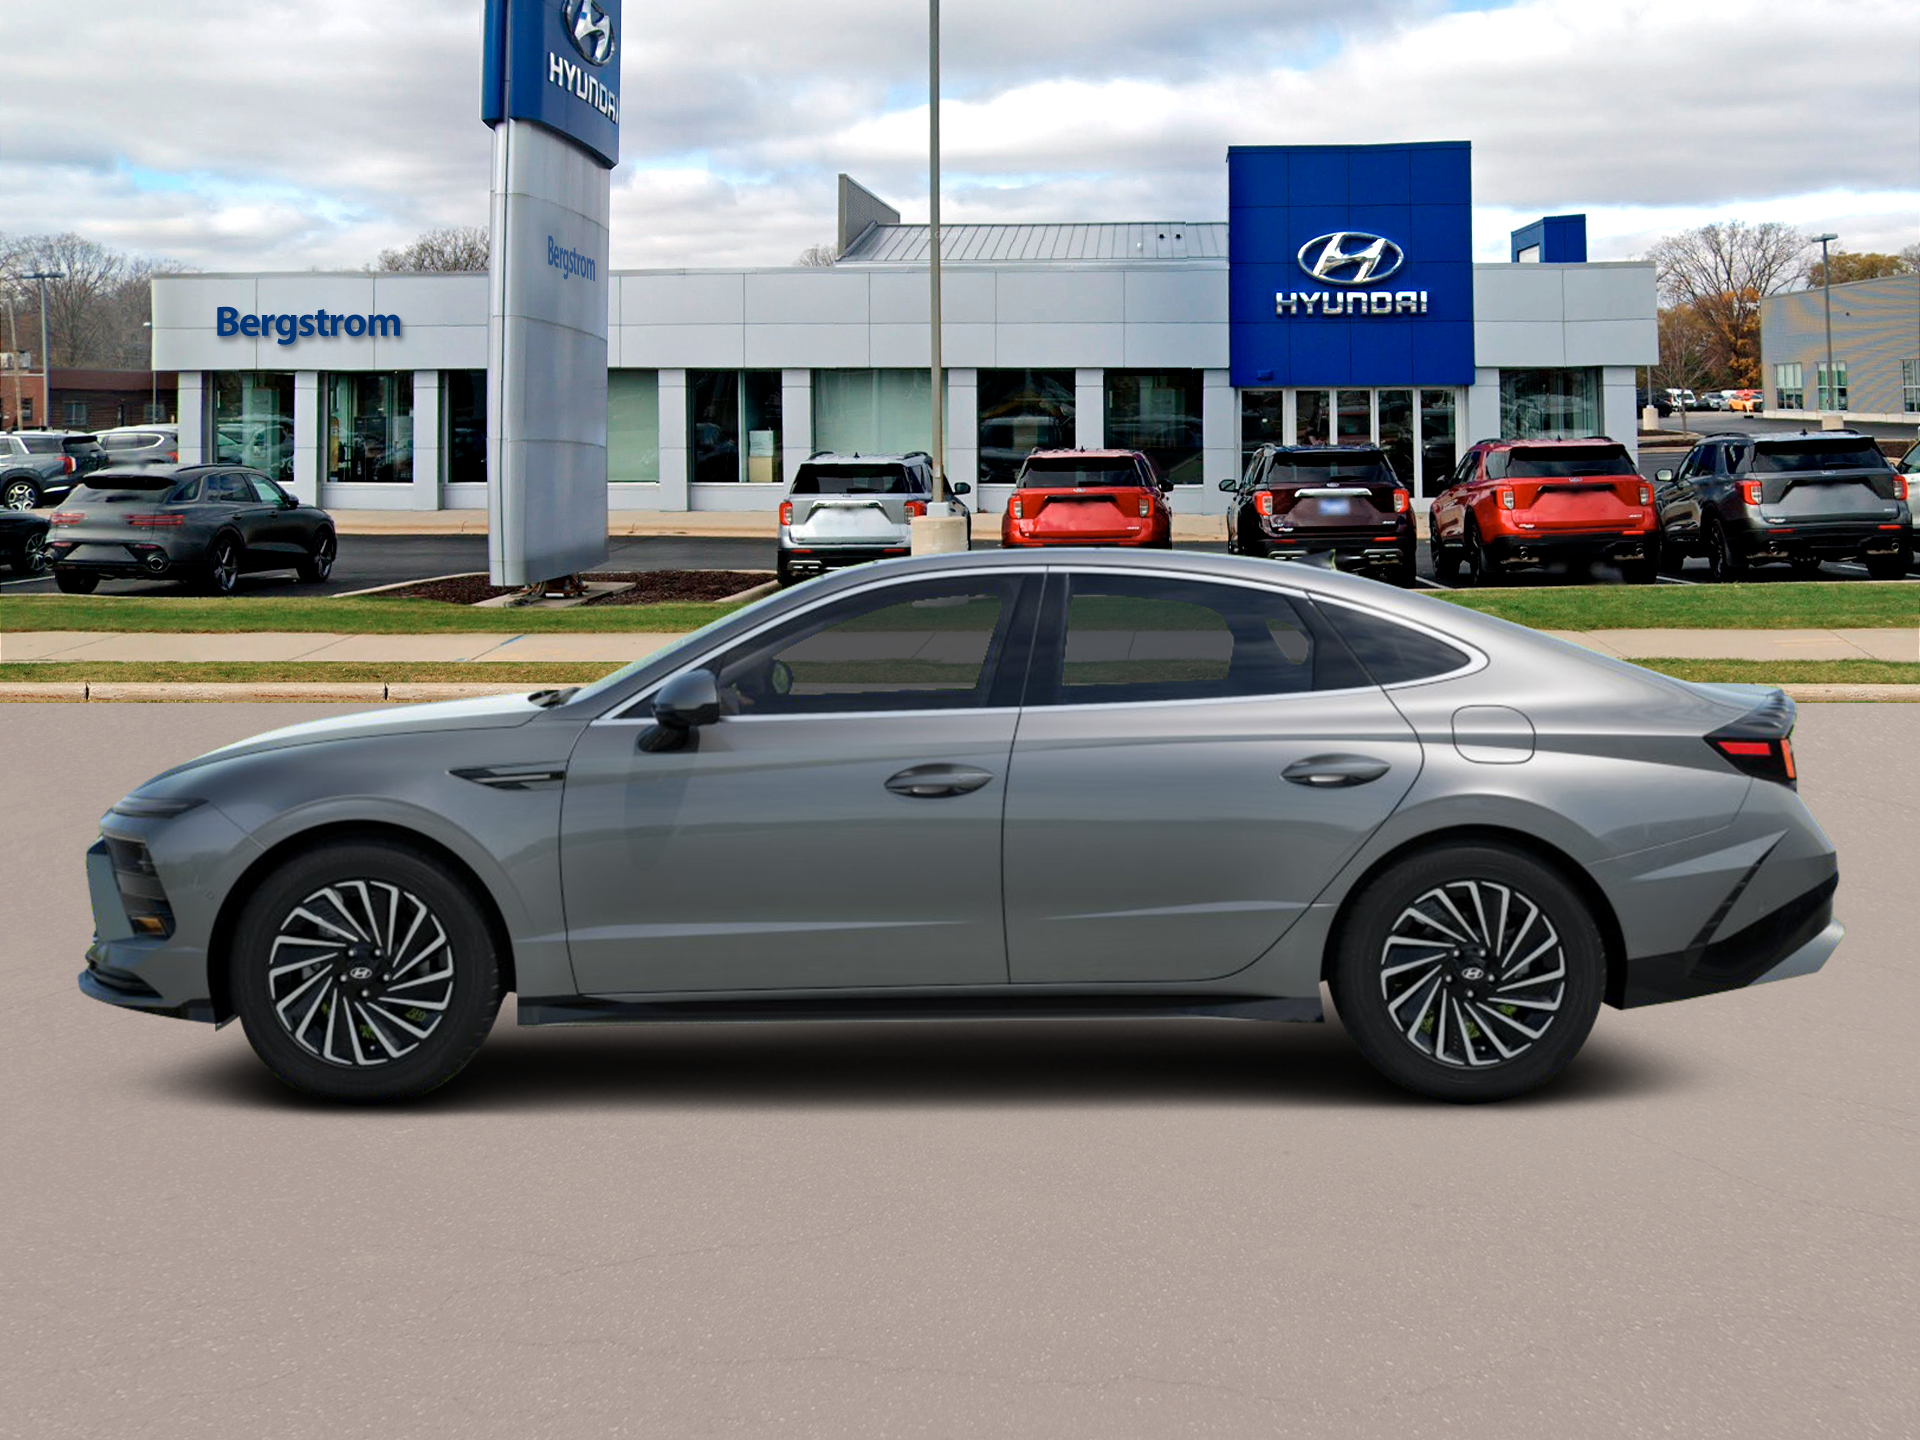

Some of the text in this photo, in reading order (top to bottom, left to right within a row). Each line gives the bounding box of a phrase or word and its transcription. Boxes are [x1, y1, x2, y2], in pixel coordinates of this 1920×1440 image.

[549, 51, 618, 124] HYUNDAI
[548, 235, 596, 282] Bergstrom
[1275, 290, 1428, 315] HYUNDAI
[217, 306, 401, 346] Bergstrom
